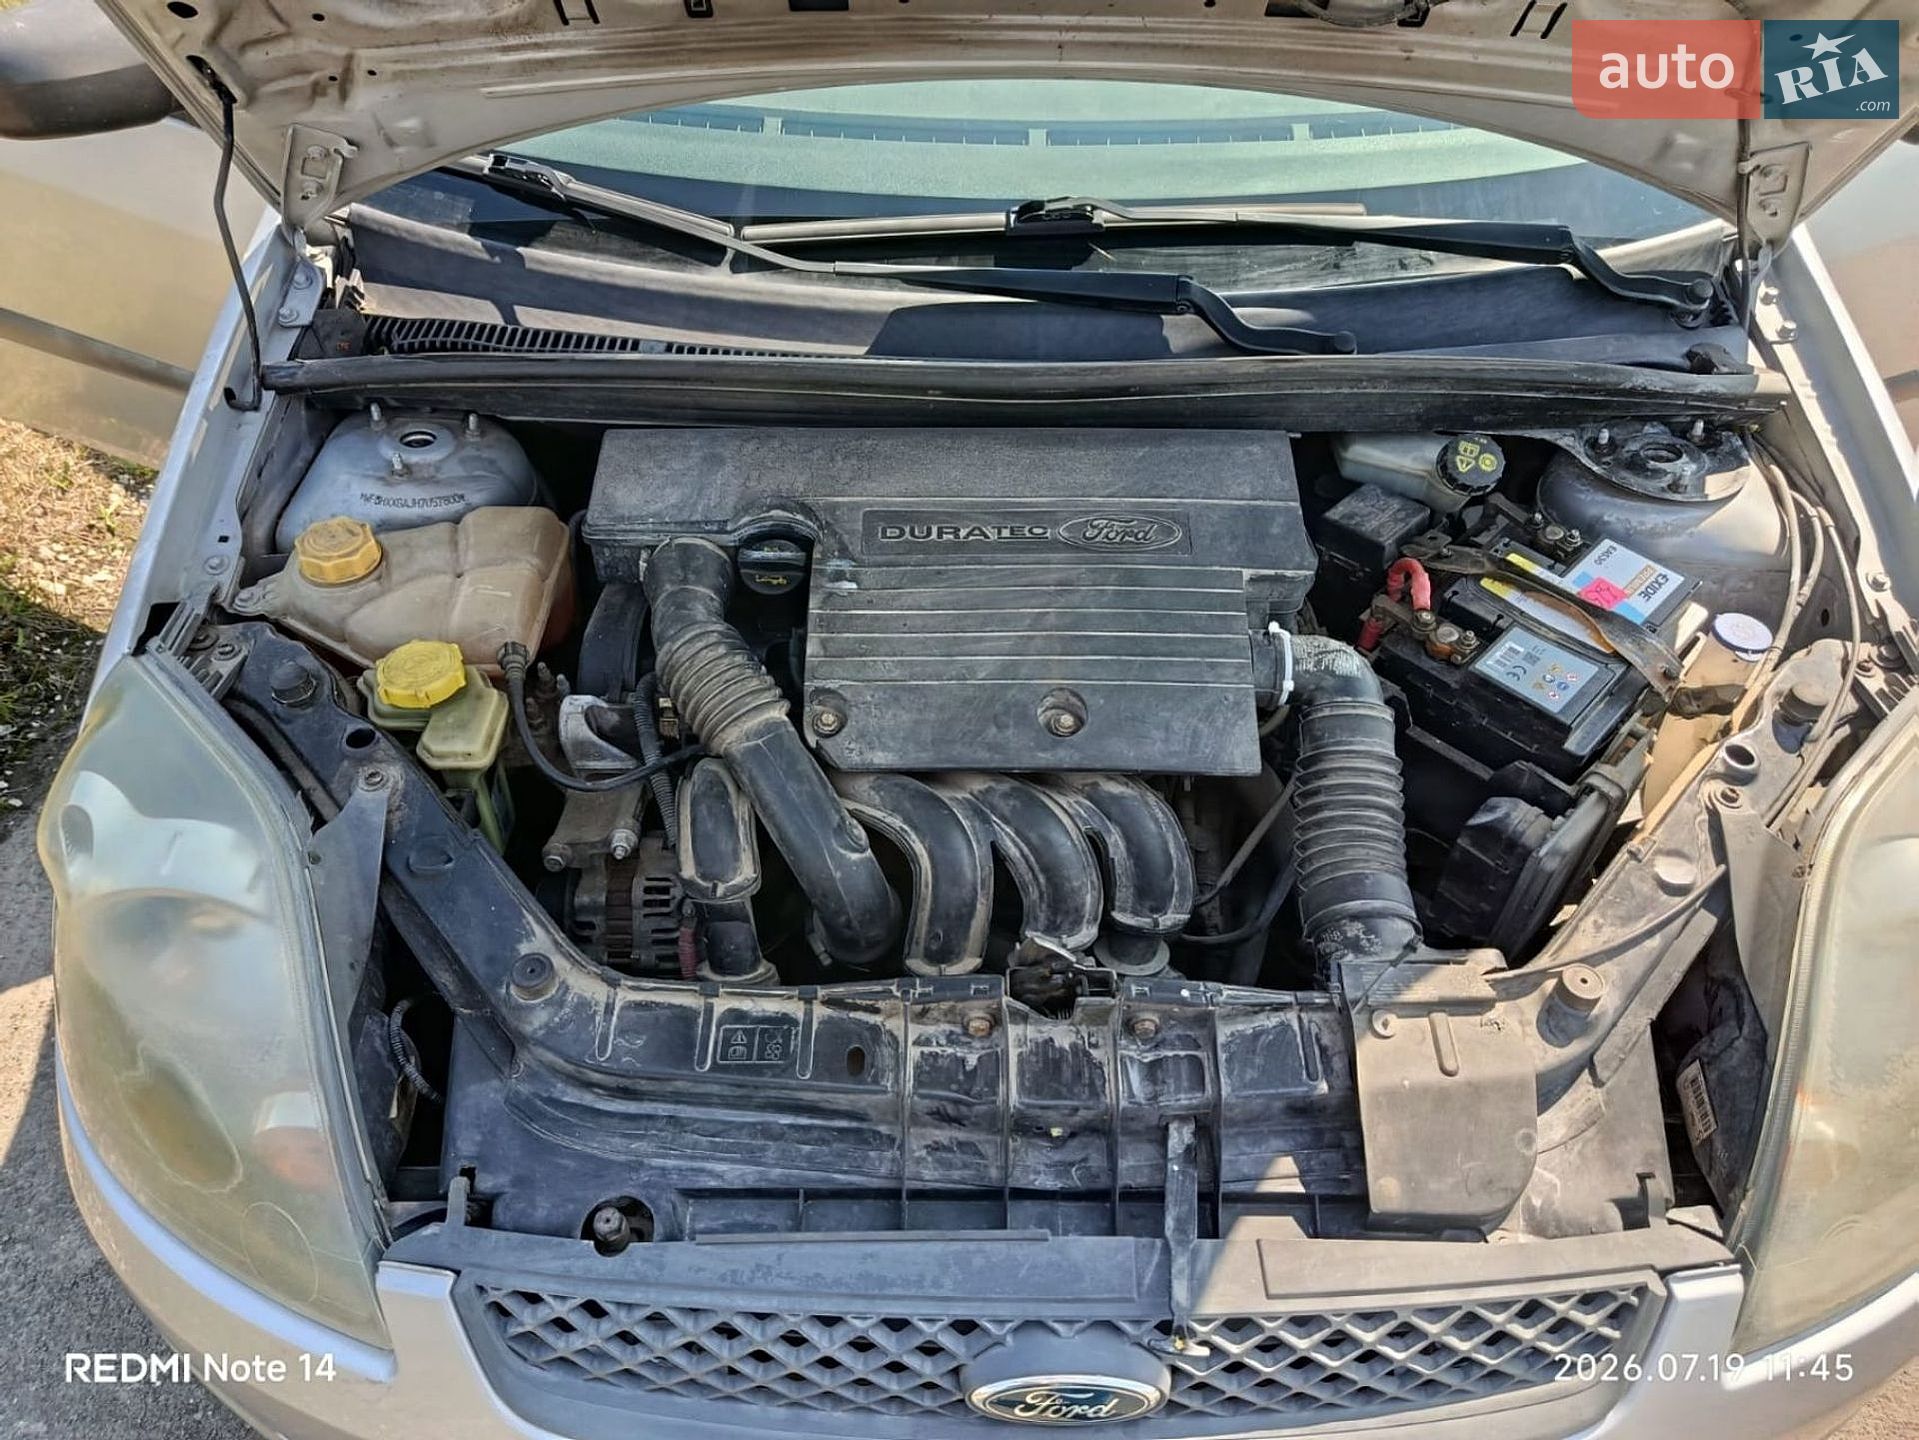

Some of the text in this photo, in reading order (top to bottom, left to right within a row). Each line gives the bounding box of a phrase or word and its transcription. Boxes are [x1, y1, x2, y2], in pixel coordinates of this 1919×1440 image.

[879, 518, 1157, 544] DURATEC Ford
[1638, 571, 1670, 602] EXIDE
[1014, 1390, 1120, 1419] Ford
